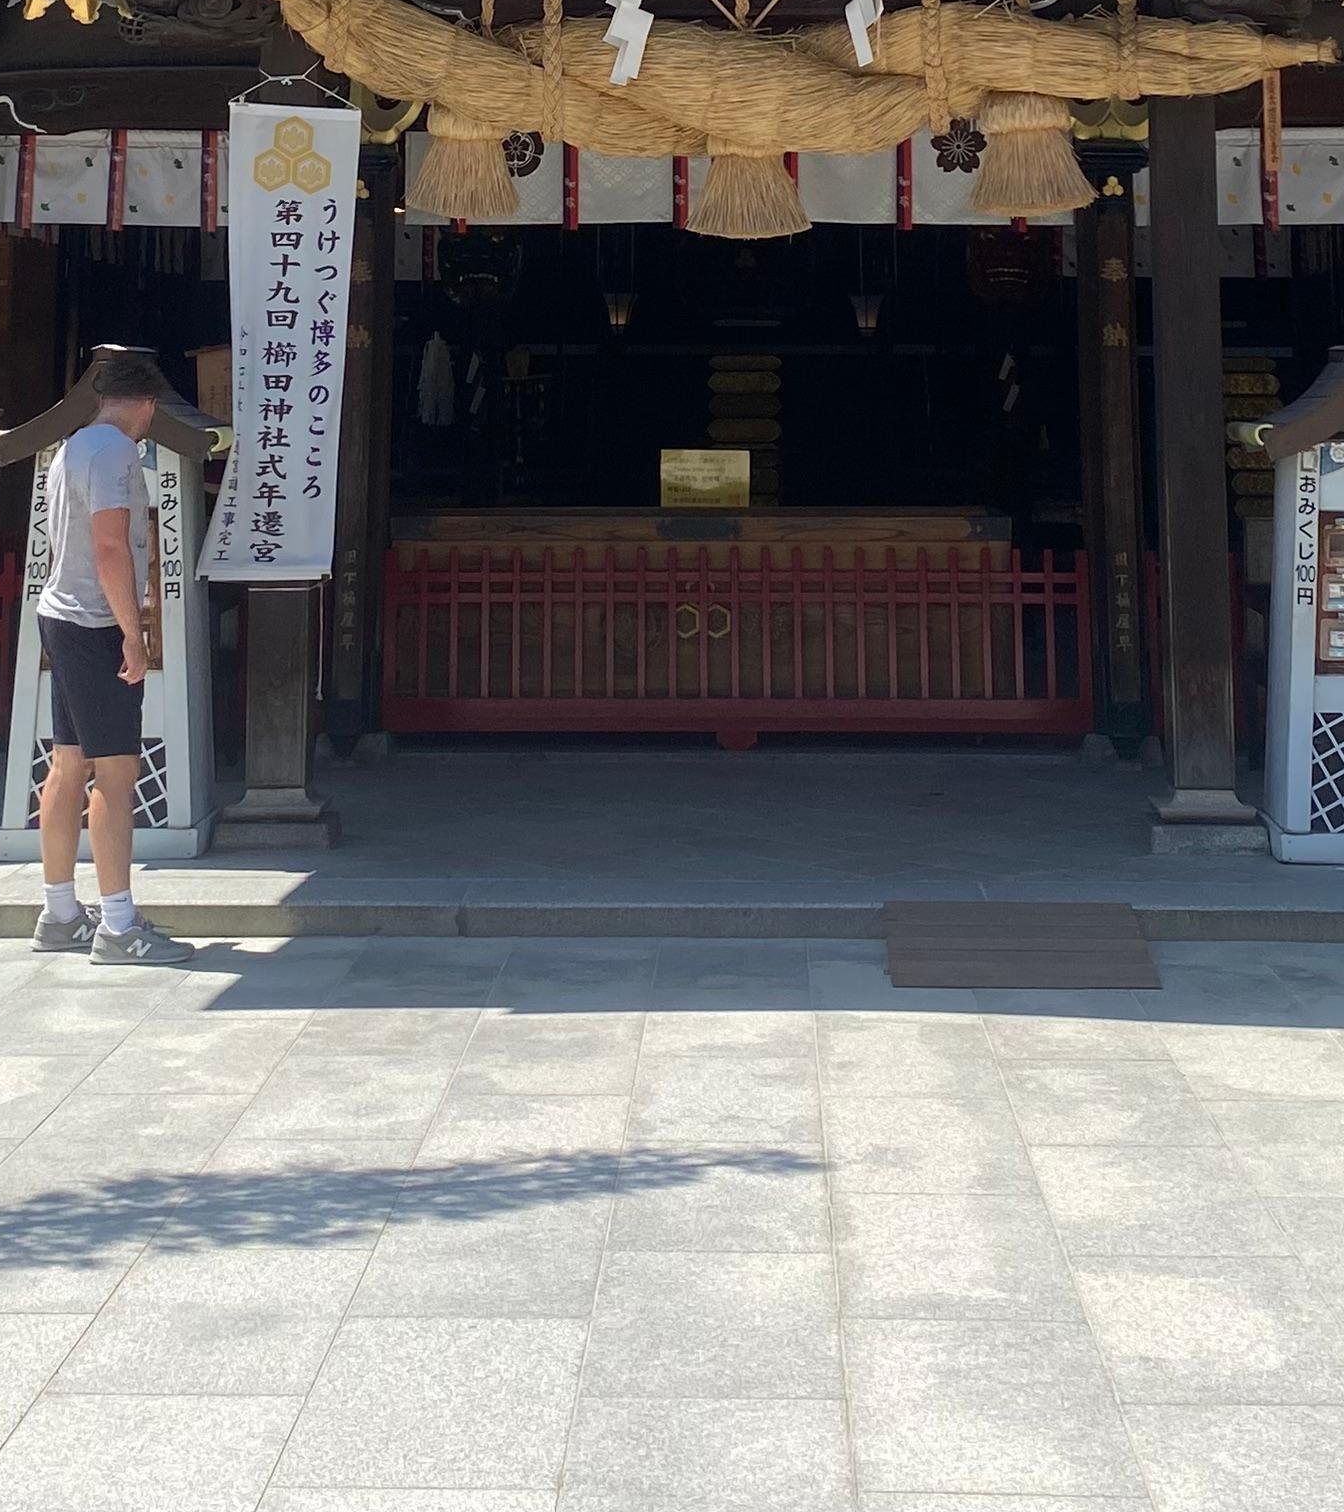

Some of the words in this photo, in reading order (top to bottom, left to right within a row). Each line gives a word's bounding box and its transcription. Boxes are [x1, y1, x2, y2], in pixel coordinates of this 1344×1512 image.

[265, 198, 303, 330] 第四十九回
[301, 197, 341, 499] うけつぐ博多のこころ
[248, 340, 298, 564] 櫛田神社式年遷宮
[27, 473, 49, 601] おみくじ100円
[159, 470, 183, 600] おみくじ100円
[1295, 475, 1316, 606] おみくじ100円
